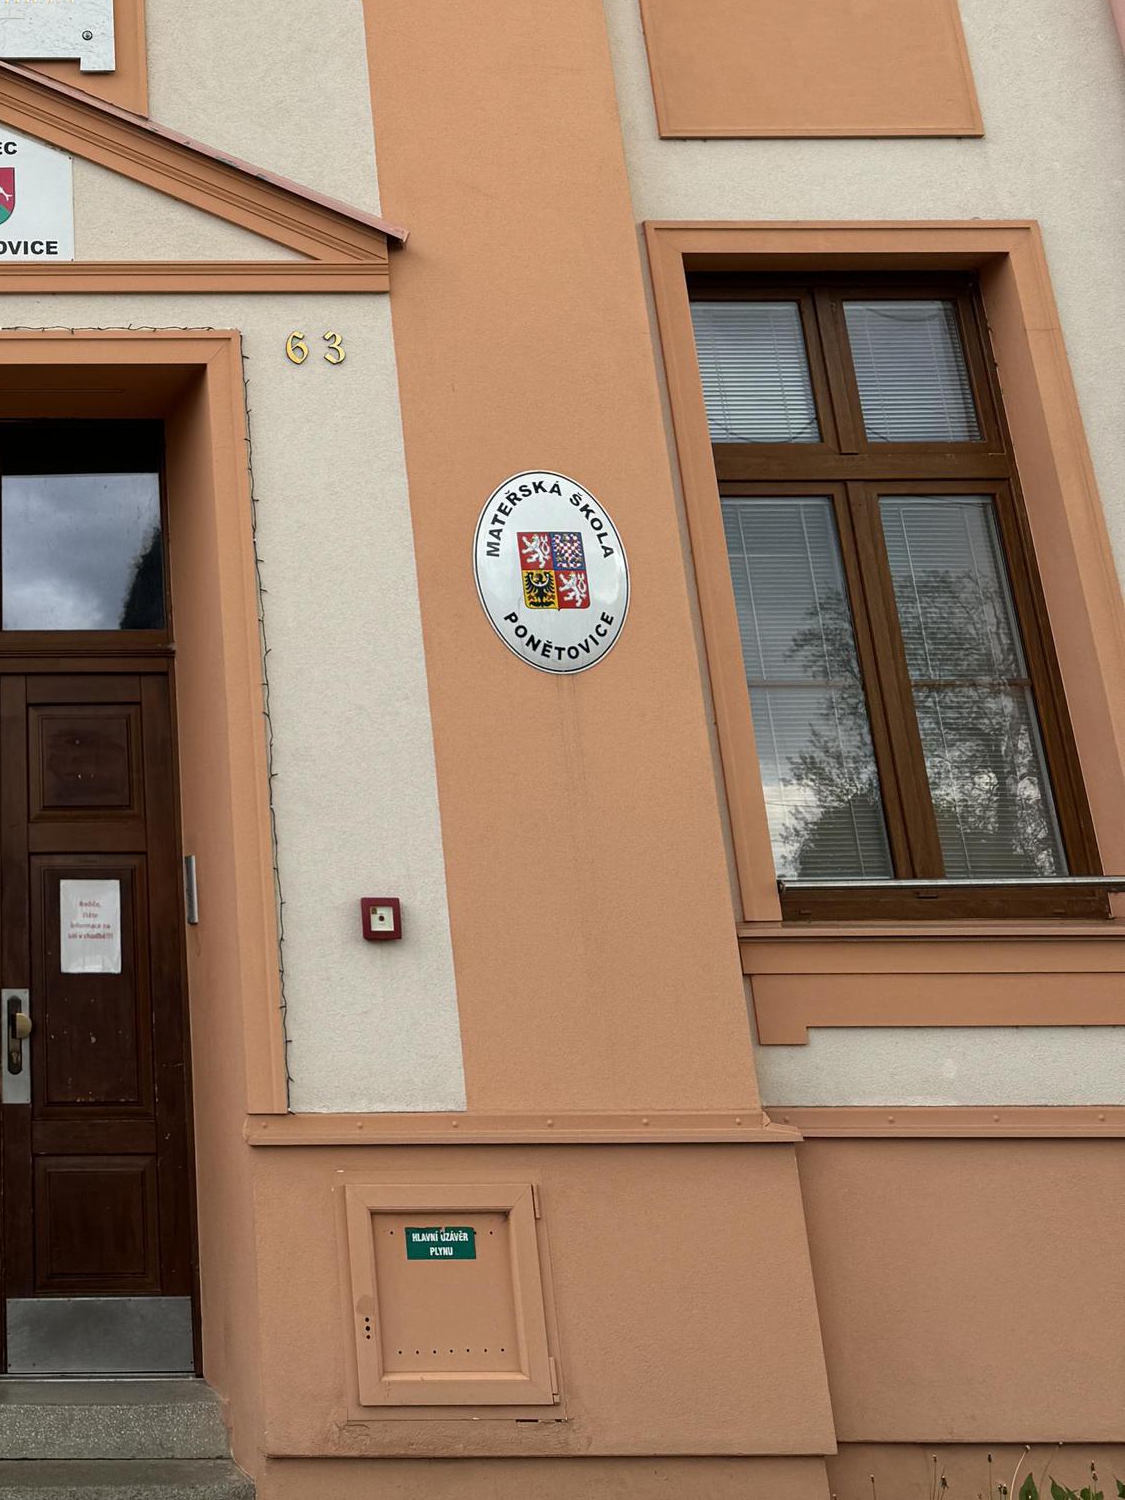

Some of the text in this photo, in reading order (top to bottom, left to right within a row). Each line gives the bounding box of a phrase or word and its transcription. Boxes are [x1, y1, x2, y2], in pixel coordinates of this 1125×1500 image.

[285, 330, 347, 365] 63
[486, 480, 615, 559] MATEŘSKÁ ŠKOLA
[504, 611, 615, 661] PONĚTOVICE
[412, 1230, 439, 1242] HLAVNÍ
[429, 1246, 454, 1256] PLYNU
